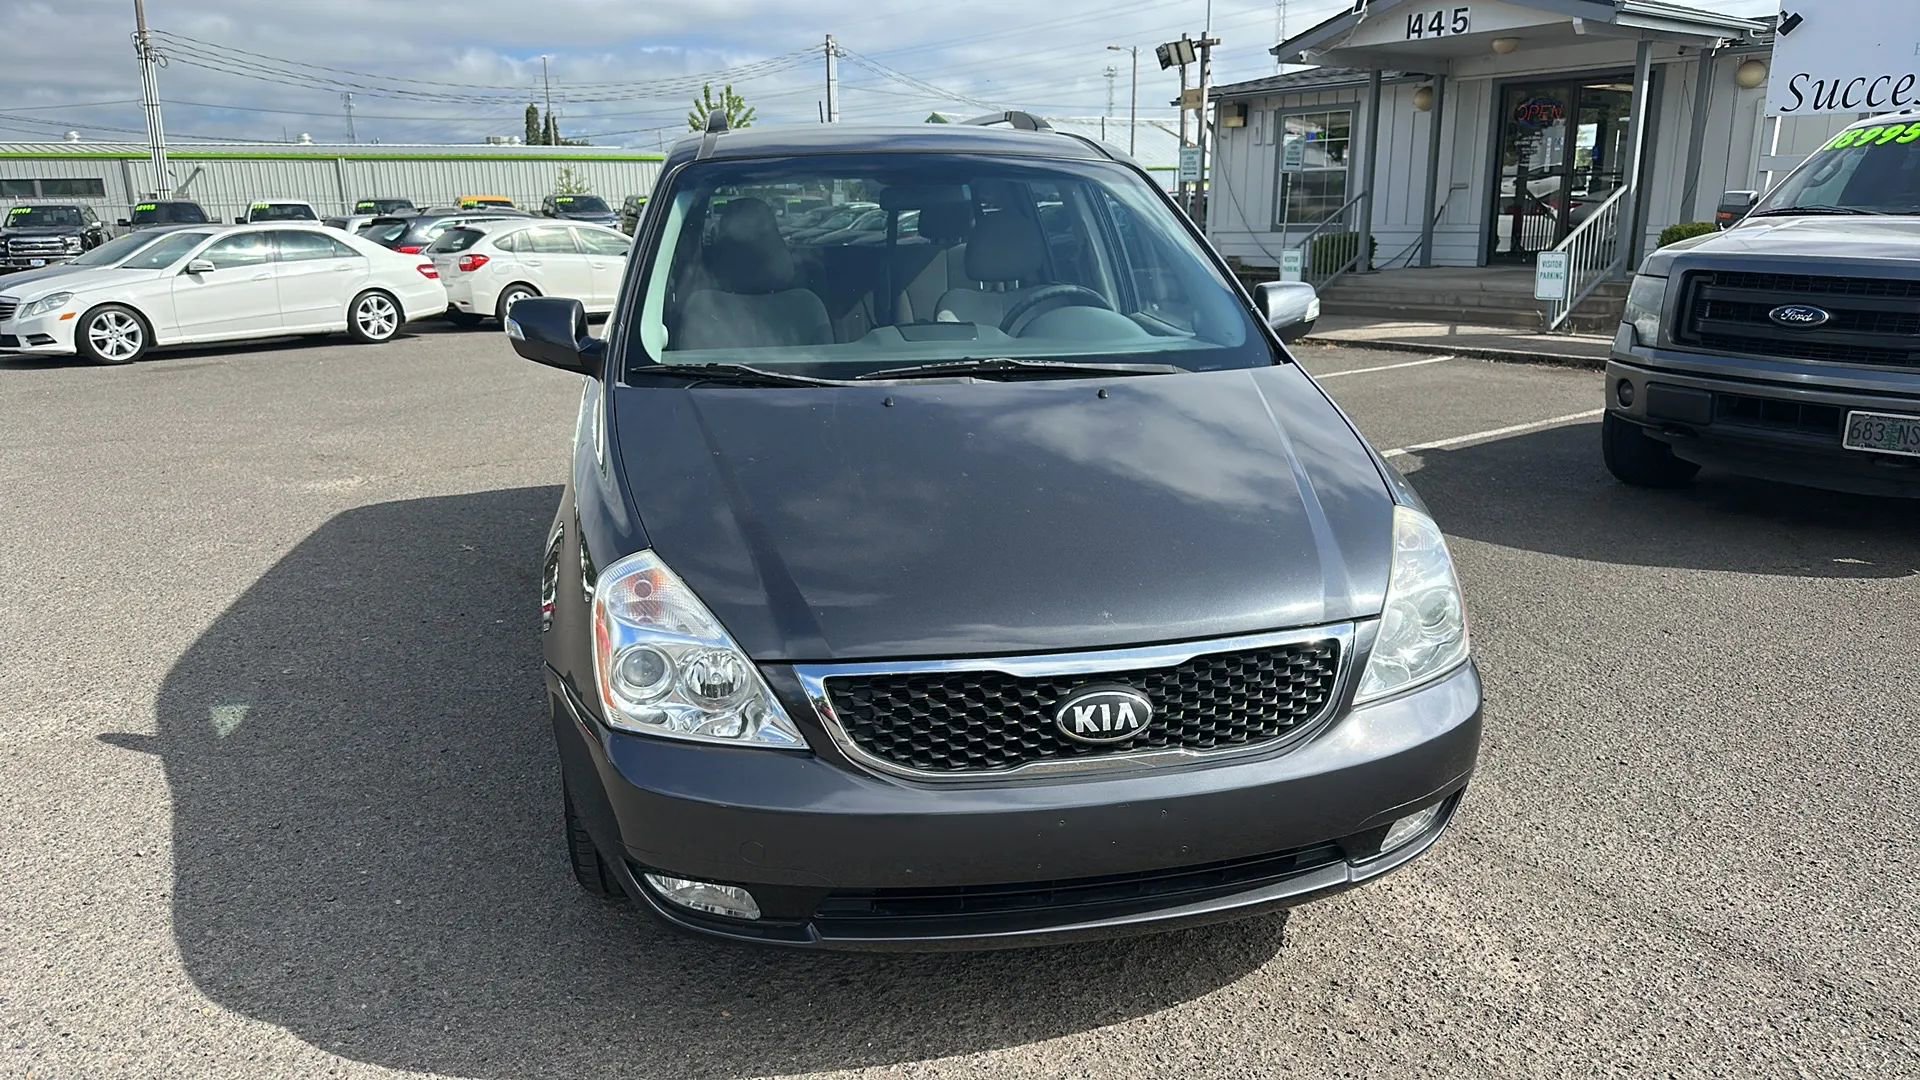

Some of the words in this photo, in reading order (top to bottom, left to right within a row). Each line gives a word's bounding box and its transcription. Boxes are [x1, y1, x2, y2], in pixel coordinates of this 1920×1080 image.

[1406, 7, 1468, 39] 1445
[1780, 73, 1920, 111] Succe
[1515, 104, 1564, 121] OPEN
[1542, 260, 1562, 268] VISITOR
[1540, 271, 1563, 280] PARKING
[1780, 308, 1813, 322] Ford
[1851, 420, 1886, 442] 683
[1072, 702, 1139, 733] KIA
